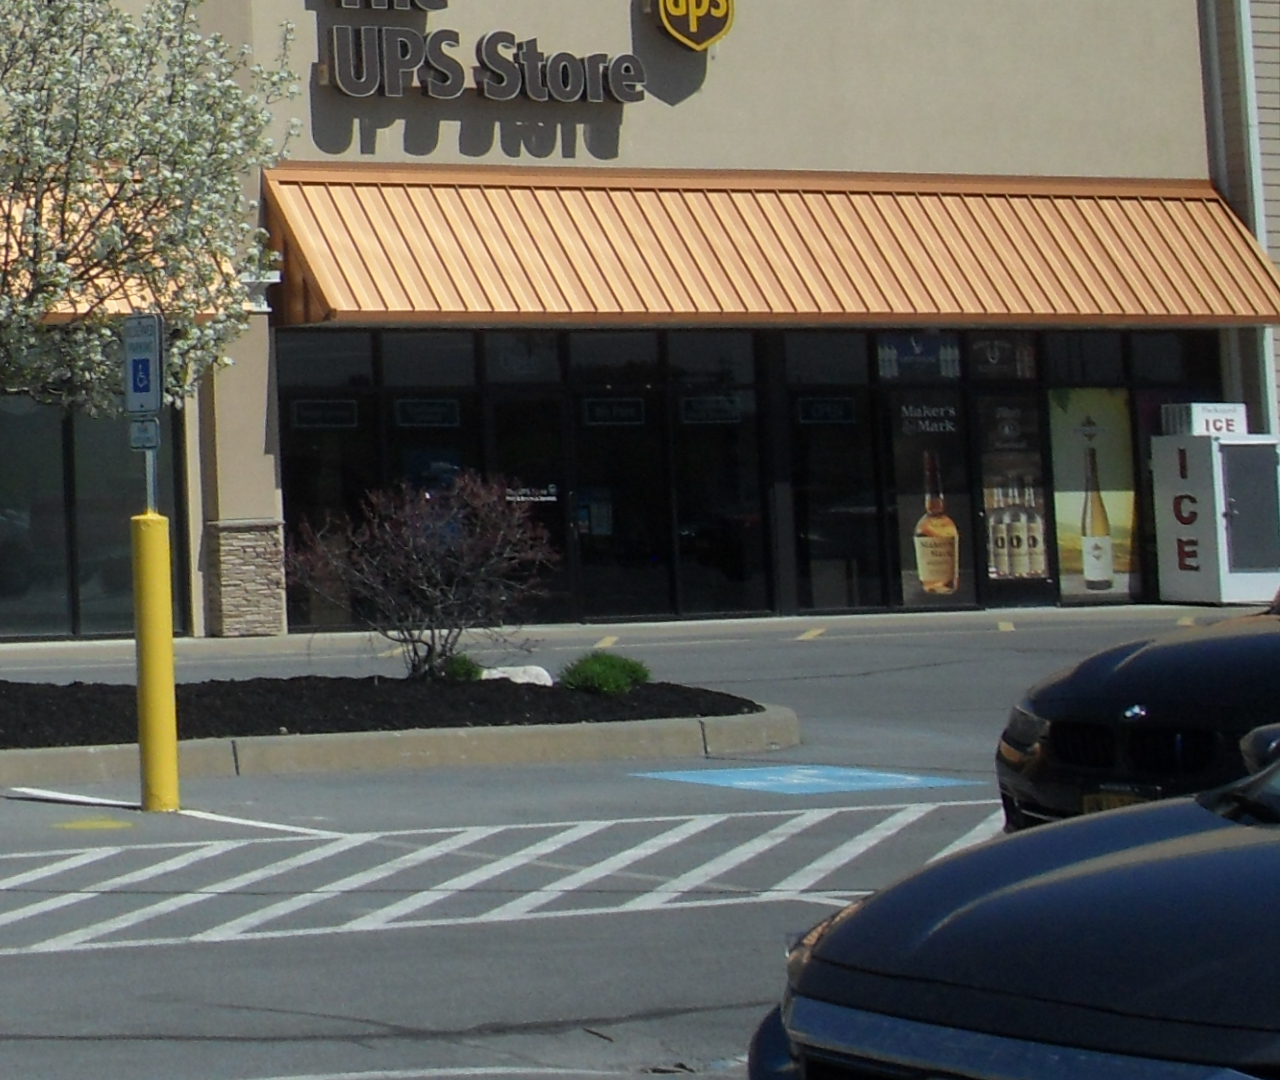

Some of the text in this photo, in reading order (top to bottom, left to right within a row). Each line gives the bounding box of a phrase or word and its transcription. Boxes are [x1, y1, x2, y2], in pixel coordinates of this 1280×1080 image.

[332, 25, 647, 103] UPS Store
[901, 405, 956, 417] Maker's
[918, 419, 956, 432] Mark
[1205, 419, 1235, 432] ICE
